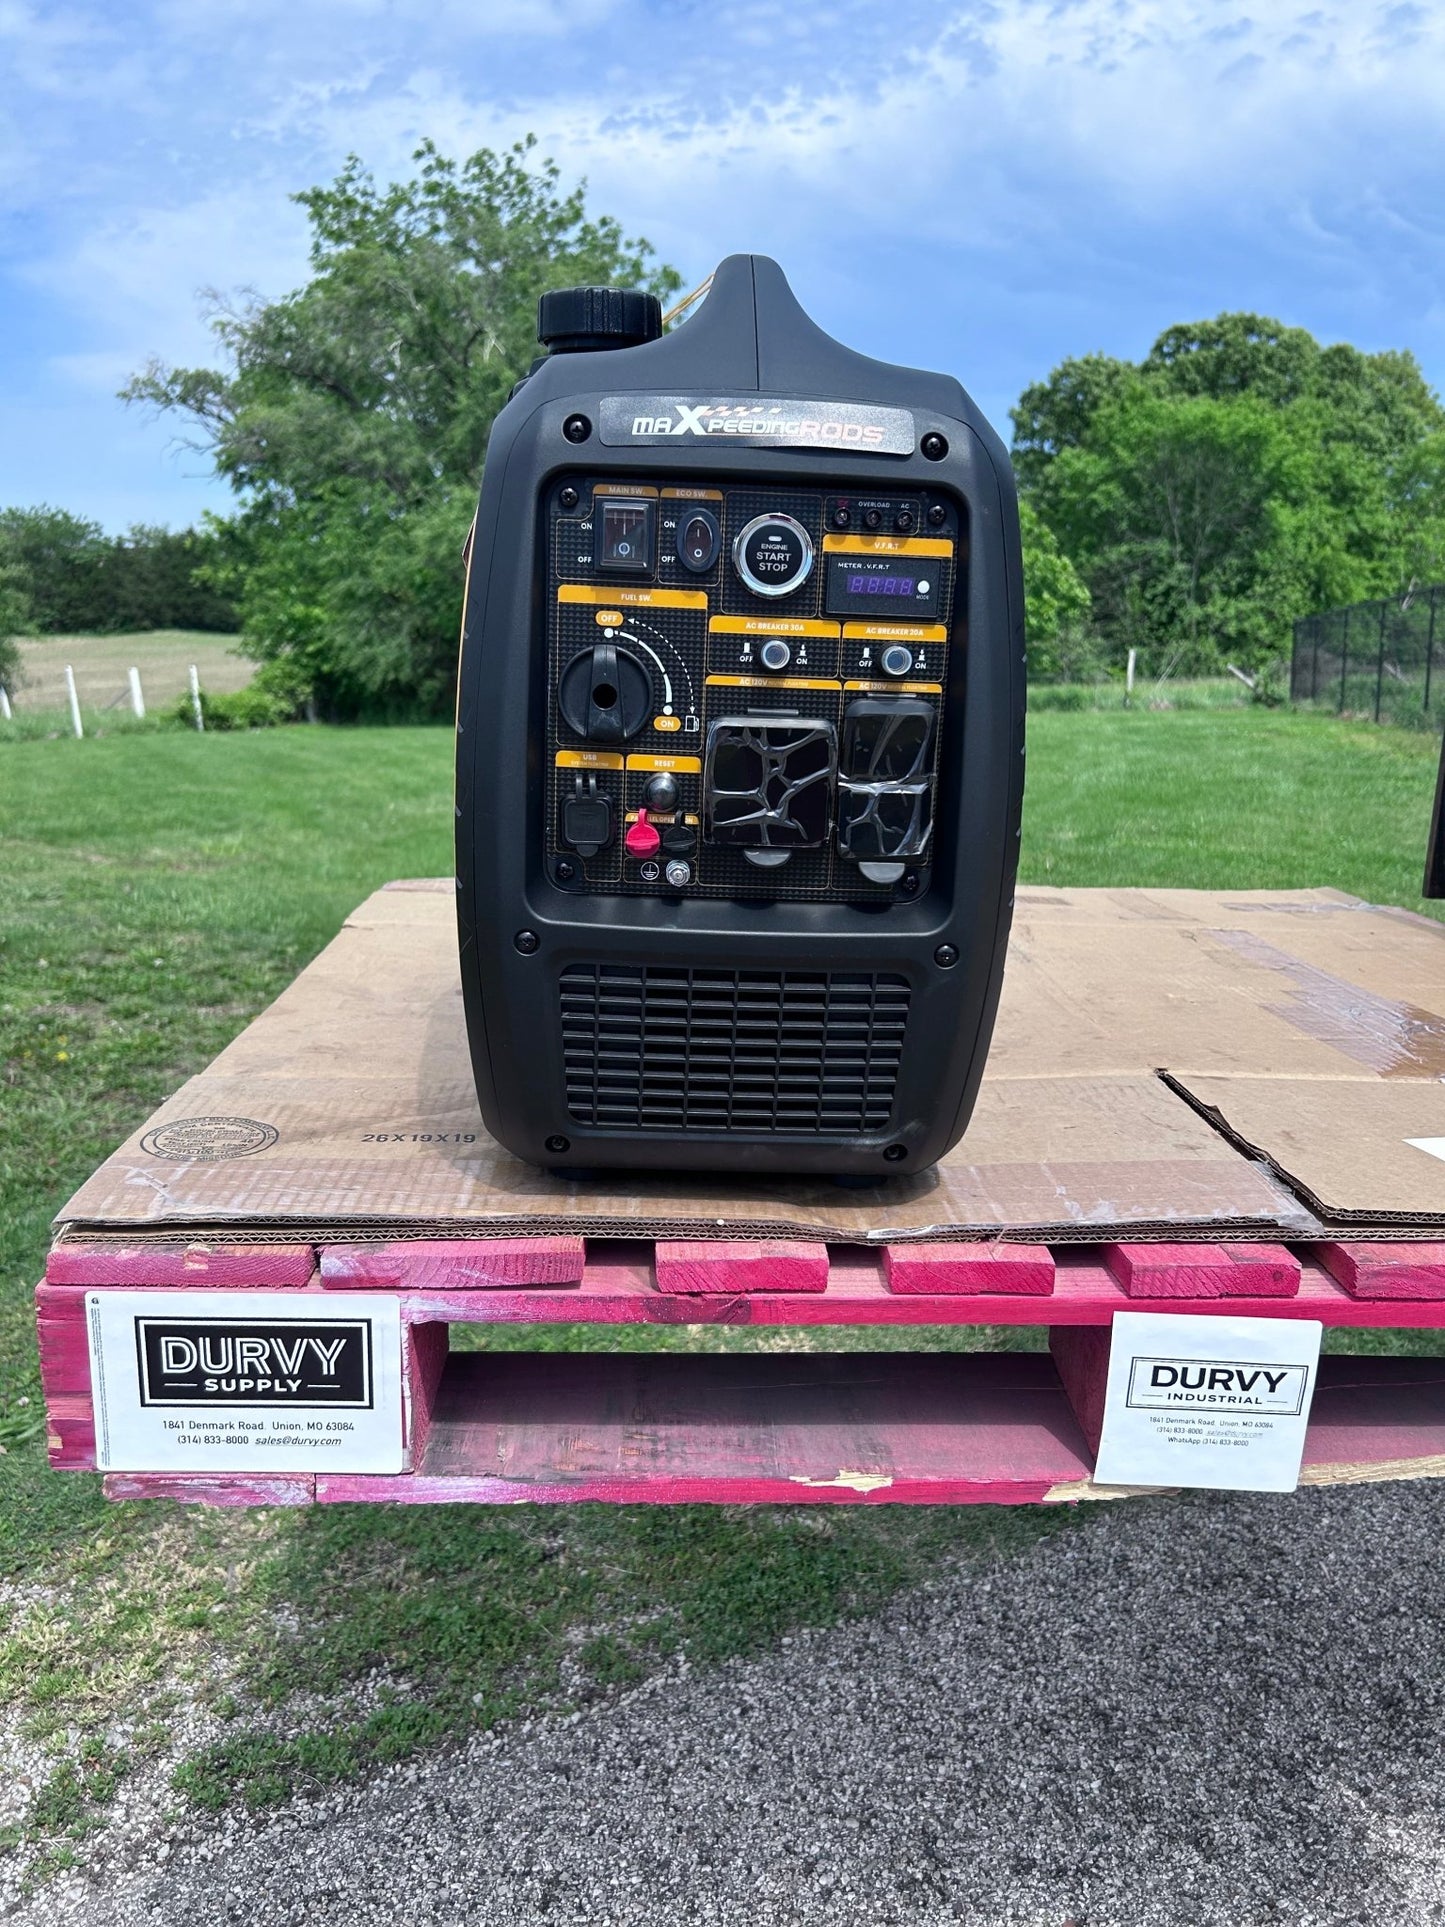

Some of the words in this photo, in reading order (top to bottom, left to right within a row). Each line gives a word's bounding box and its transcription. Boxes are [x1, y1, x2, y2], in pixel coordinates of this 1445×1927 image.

[608, 486, 629, 495] MAIN
[676, 490, 691, 498] ECO
[581, 522, 593, 530] ON
[664, 520, 676, 529] ON
[761, 543, 788, 551] ENGINE
[578, 555, 592, 563] OFF
[661, 555, 676, 563] OFF
[756, 551, 792, 562] START
[759, 562, 788, 572] STOP
[621, 593, 636, 601] FUEL
[601, 613, 618, 623] OFF
[746, 622, 757, 630] AC
[758, 623, 789, 631] BREAKER
[790, 624, 805, 632] 30A
[866, 627, 876, 635] AC
[877, 628, 908, 636] BREAKER
[909, 629, 924, 637] 20A
[739, 654, 753, 662] OFF
[796, 657, 808, 665] ON
[859, 659, 873, 668] OFF
[751, 678, 767, 686] 120V
[859, 682, 869, 690] AC
[870, 682, 887, 690] 120V
[660, 719, 674, 729] ON
[654, 760, 675, 768] RESET
[159, 1336, 347, 1376] DURVY
[1150, 1365, 1288, 1393] DURVY
[204, 1378, 302, 1393] SUPPLY
[1167, 1392, 1263, 1405] INDUSTRIAL
[163, 1420, 185, 1430] 1841
[188, 1420, 236, 1431] Denmark
[307, 1422, 323, 1431] MO
[325, 1422, 355, 1431] 63084
[1150, 1416, 1164, 1424] 1841
[1165, 1417, 1196, 1425] Denmark
[1254, 1421, 1274, 1429] 63084
[1173, 1427, 1203, 1435] 833-8000
[177, 1435, 202, 1446] (314)
[204, 1436, 249, 1445] 833-8000
[1167, 1436, 1201, 1445] WhatsApp
[1202, 1438, 1218, 1446] (314)
[1219, 1438, 1249, 1447] 833-8000
